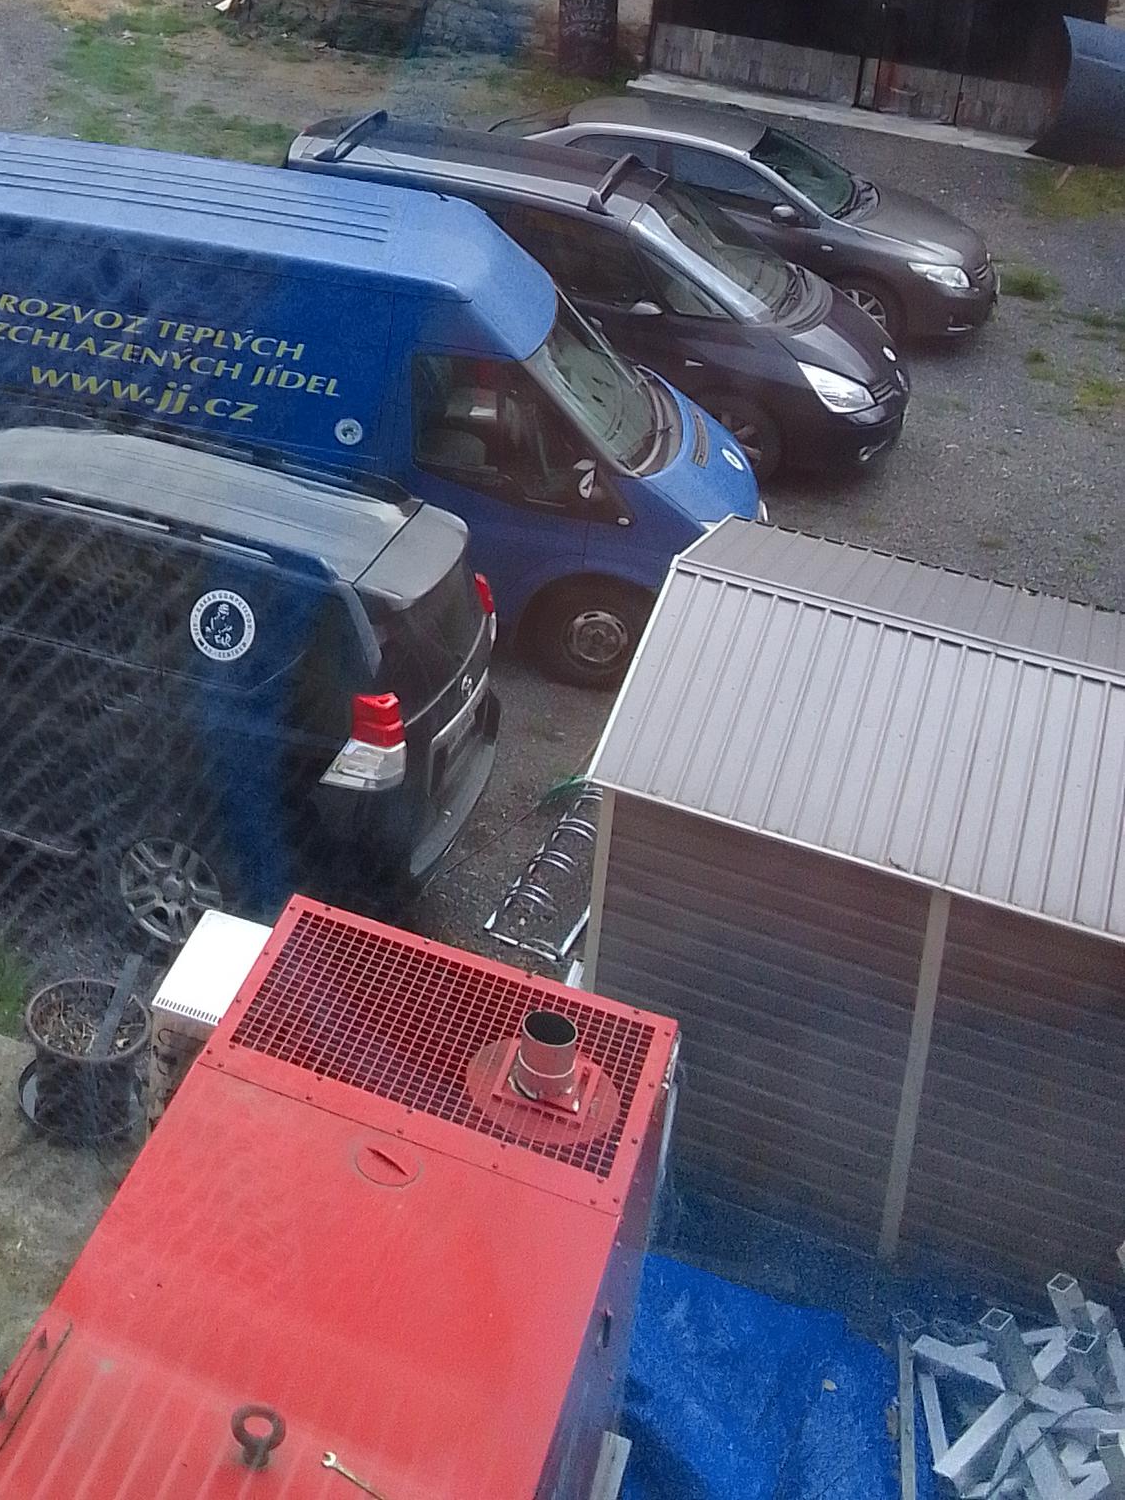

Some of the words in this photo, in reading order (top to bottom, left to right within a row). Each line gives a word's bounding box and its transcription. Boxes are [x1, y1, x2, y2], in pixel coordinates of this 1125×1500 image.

[159, 319, 305, 361] TEPLÝCH
[31, 366, 259, 423] www.jj.cz
[250, 364, 341, 399] JÍDEL
